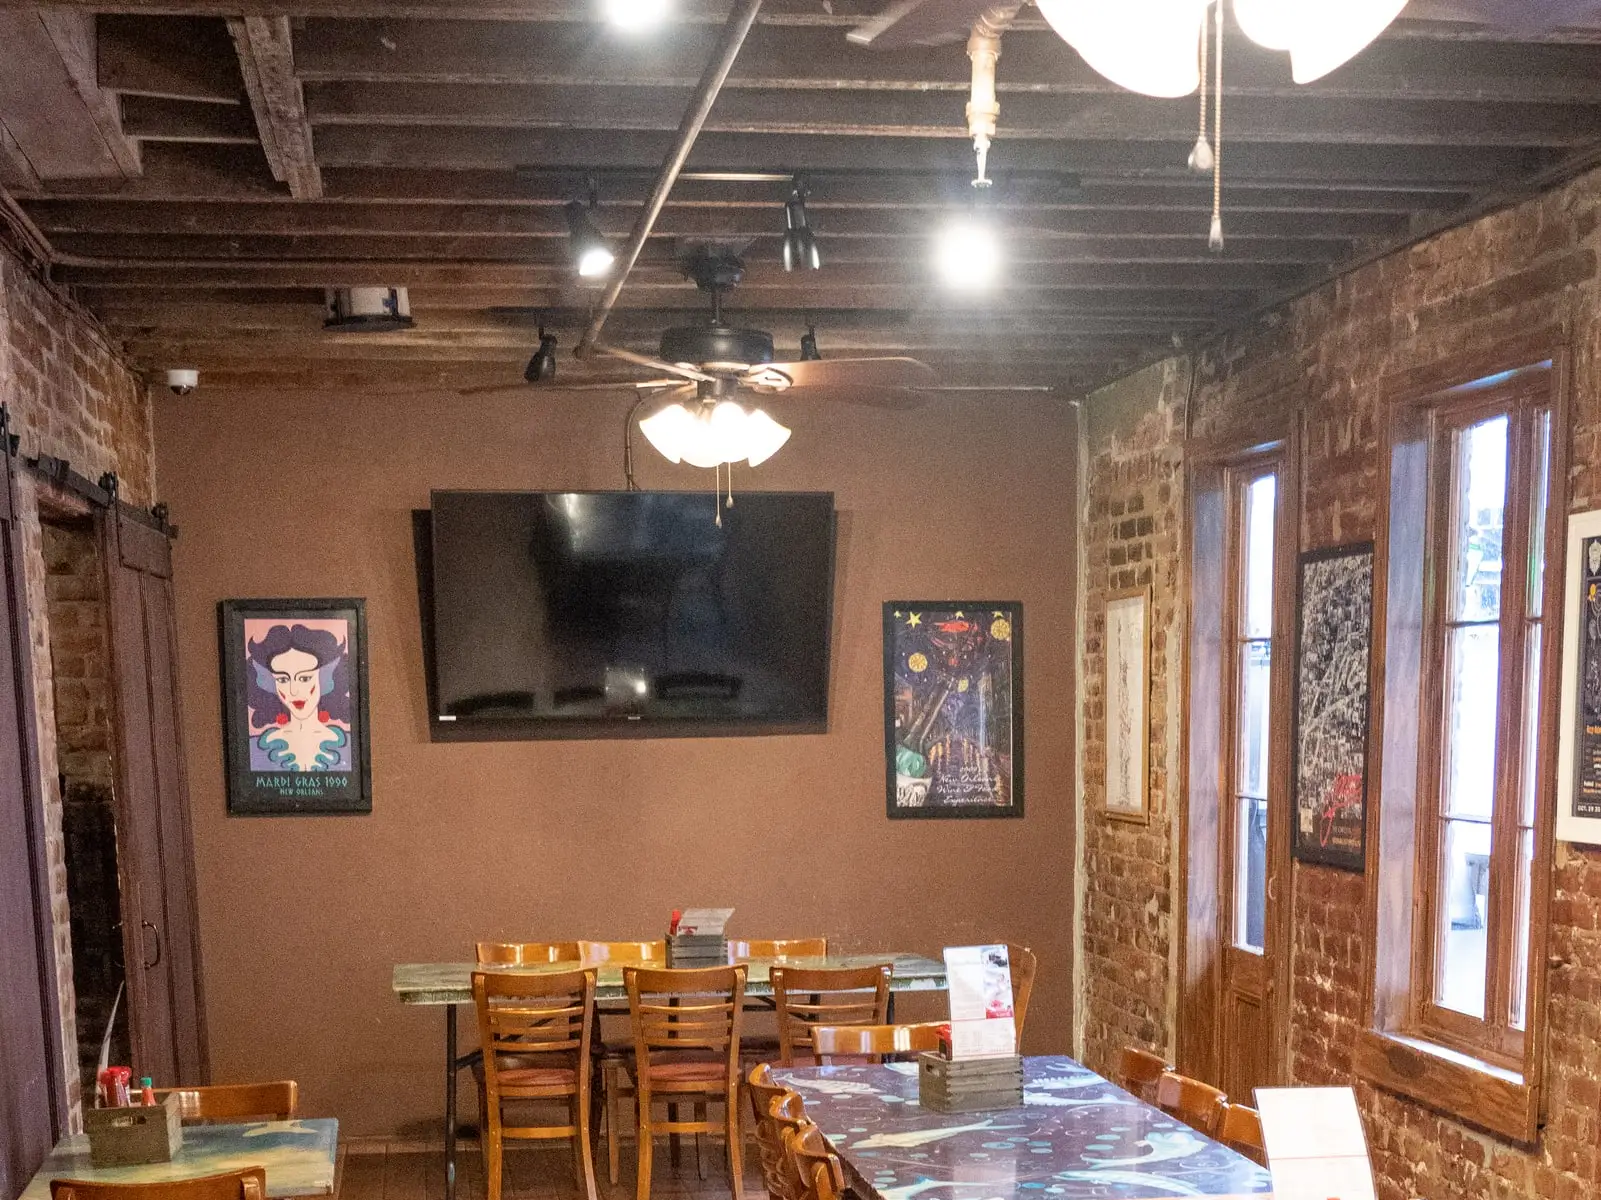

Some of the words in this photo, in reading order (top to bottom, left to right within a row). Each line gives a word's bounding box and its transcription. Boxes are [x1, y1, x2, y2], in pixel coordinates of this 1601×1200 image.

[256, 776, 290, 788] MARDI
[295, 776, 321, 788] GRAS
[280, 787, 294, 796] NEW
[296, 787, 324, 797] ORLEANS
